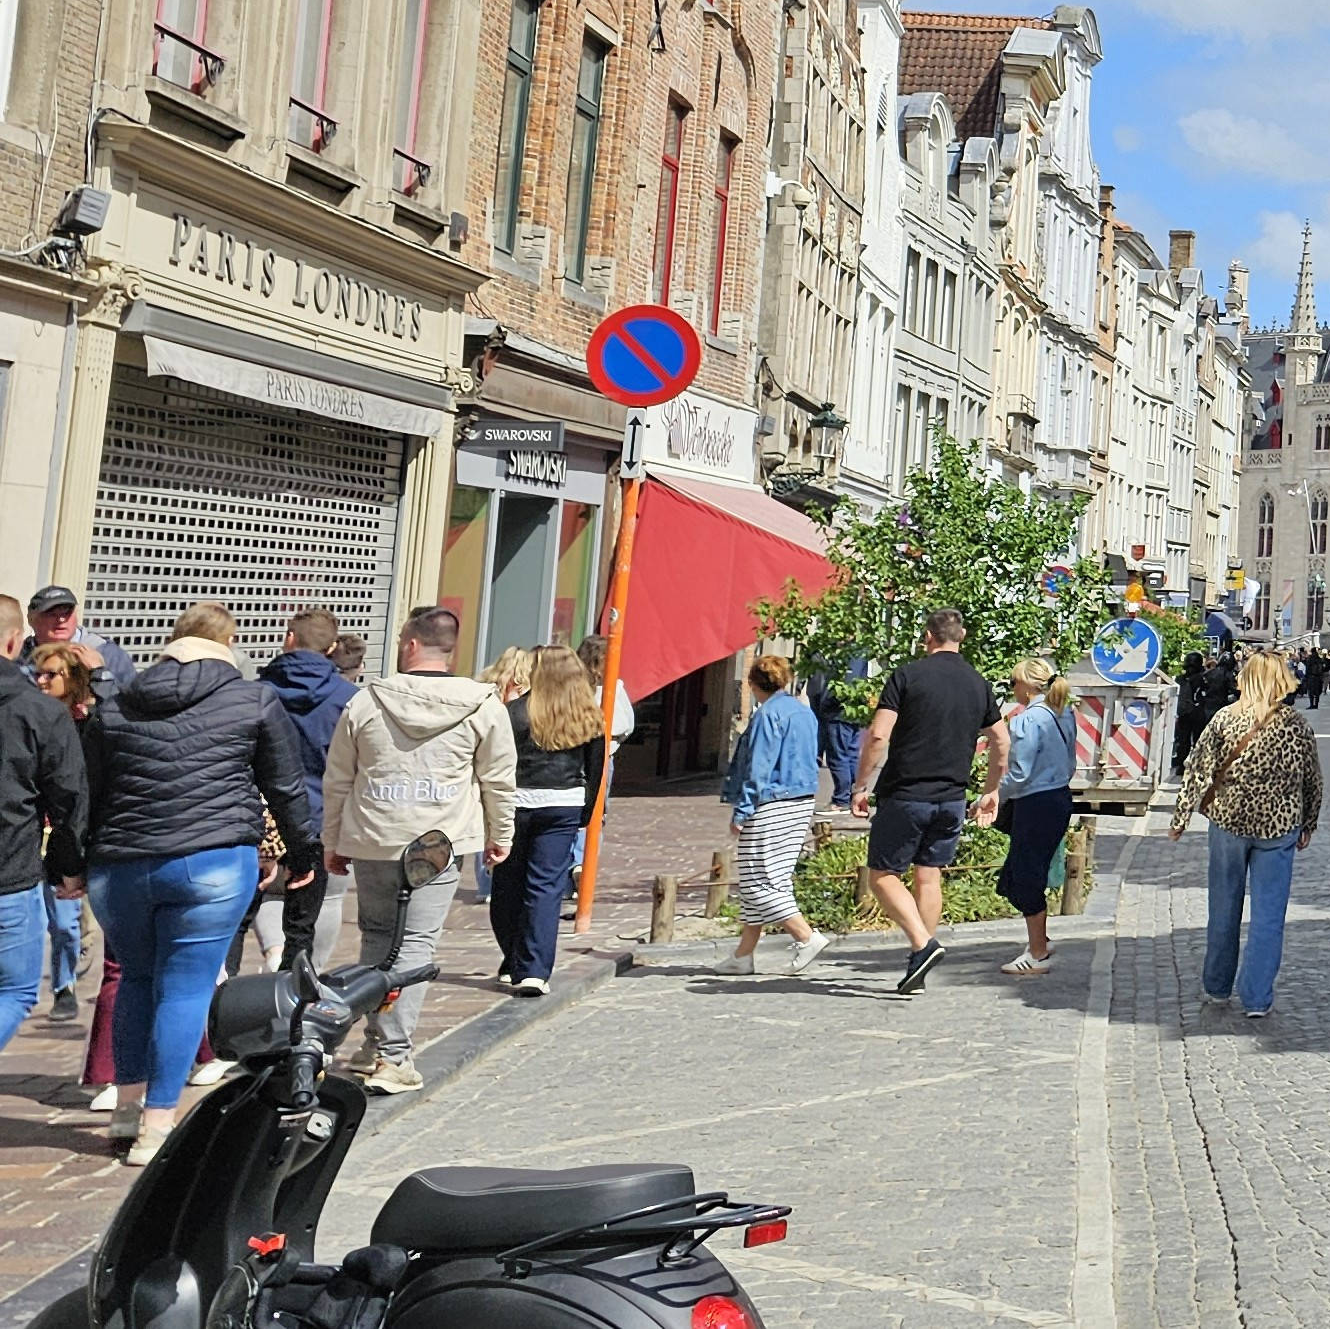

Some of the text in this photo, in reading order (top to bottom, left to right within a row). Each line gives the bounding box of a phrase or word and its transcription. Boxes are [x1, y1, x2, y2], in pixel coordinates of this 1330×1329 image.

[169, 213, 422, 342] PARIS LONDRES
[266, 371, 365, 420] PARIS LONDRES
[484, 429, 552, 442] SWAROVSKI
[508, 449, 567, 484] SWAROVSKI
[415, 779, 458, 802] Blue
